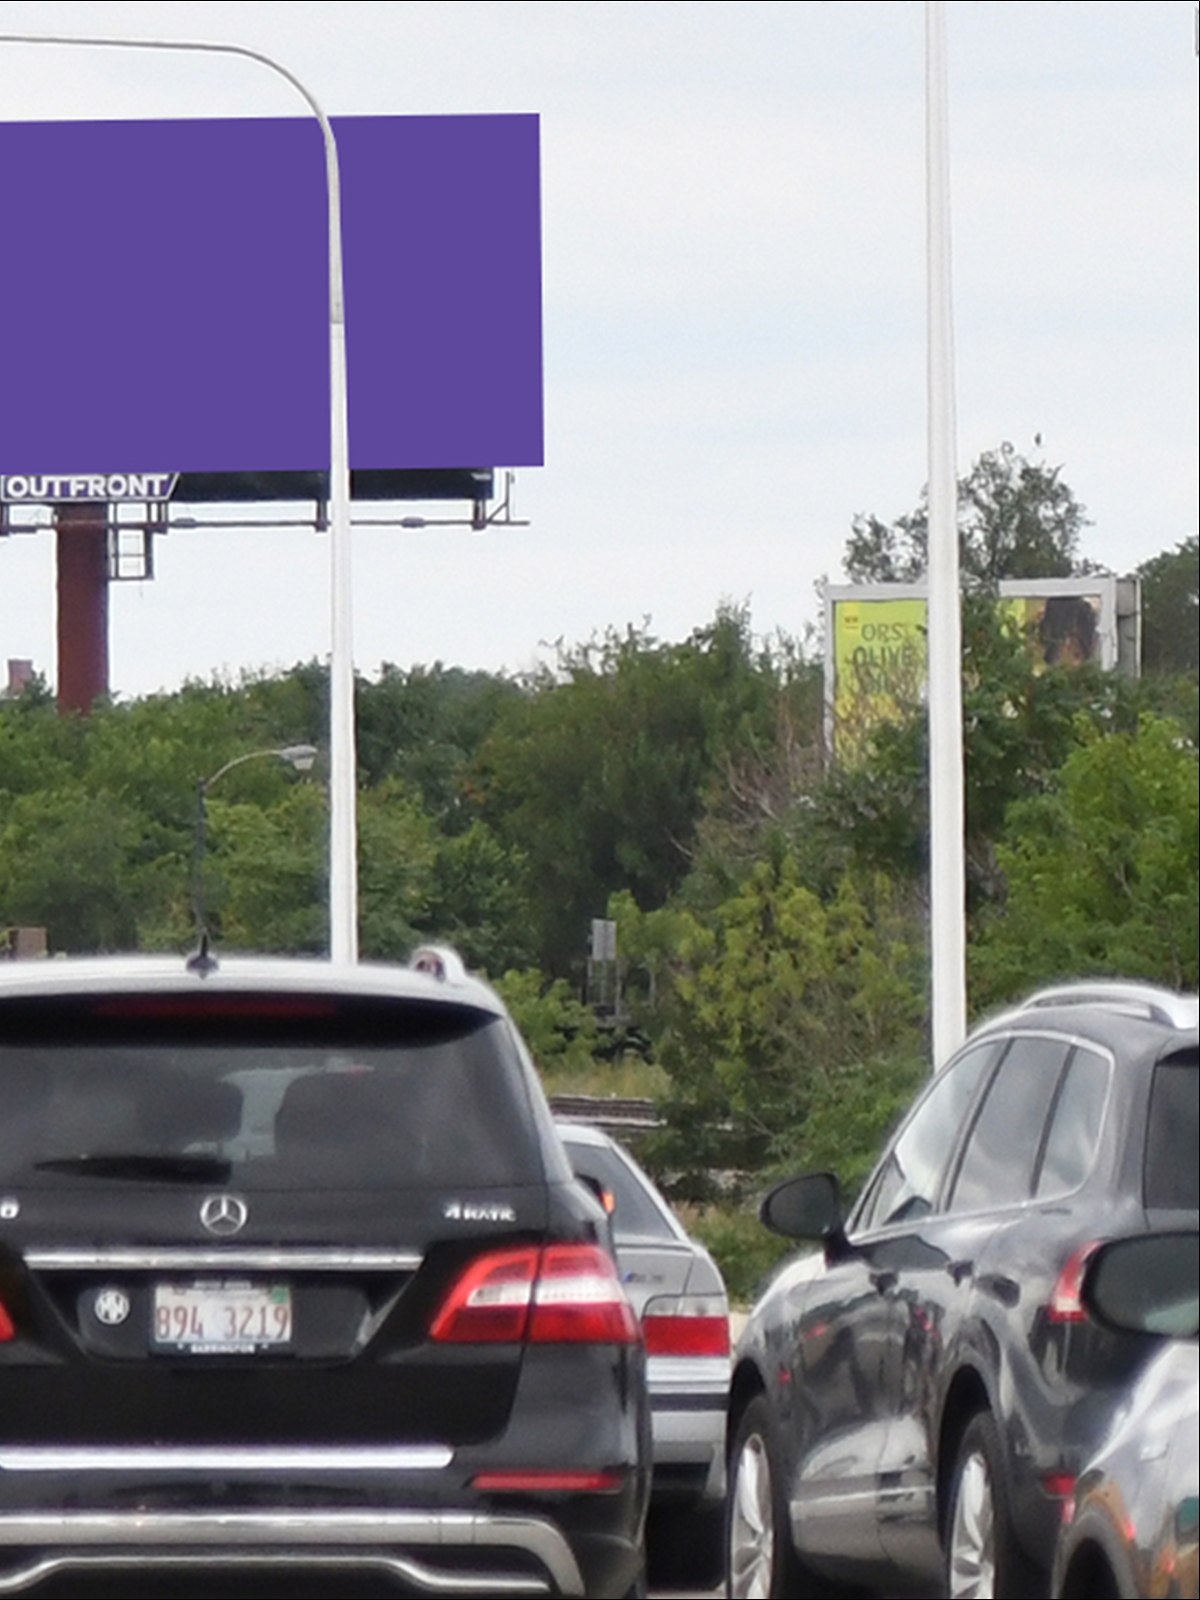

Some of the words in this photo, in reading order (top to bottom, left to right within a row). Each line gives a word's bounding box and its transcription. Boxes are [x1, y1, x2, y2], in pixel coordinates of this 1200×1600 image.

[6, 473, 169, 498] OUTFRONT
[156, 1305, 204, 1339] 894
[224, 1305, 288, 1339] 3219
